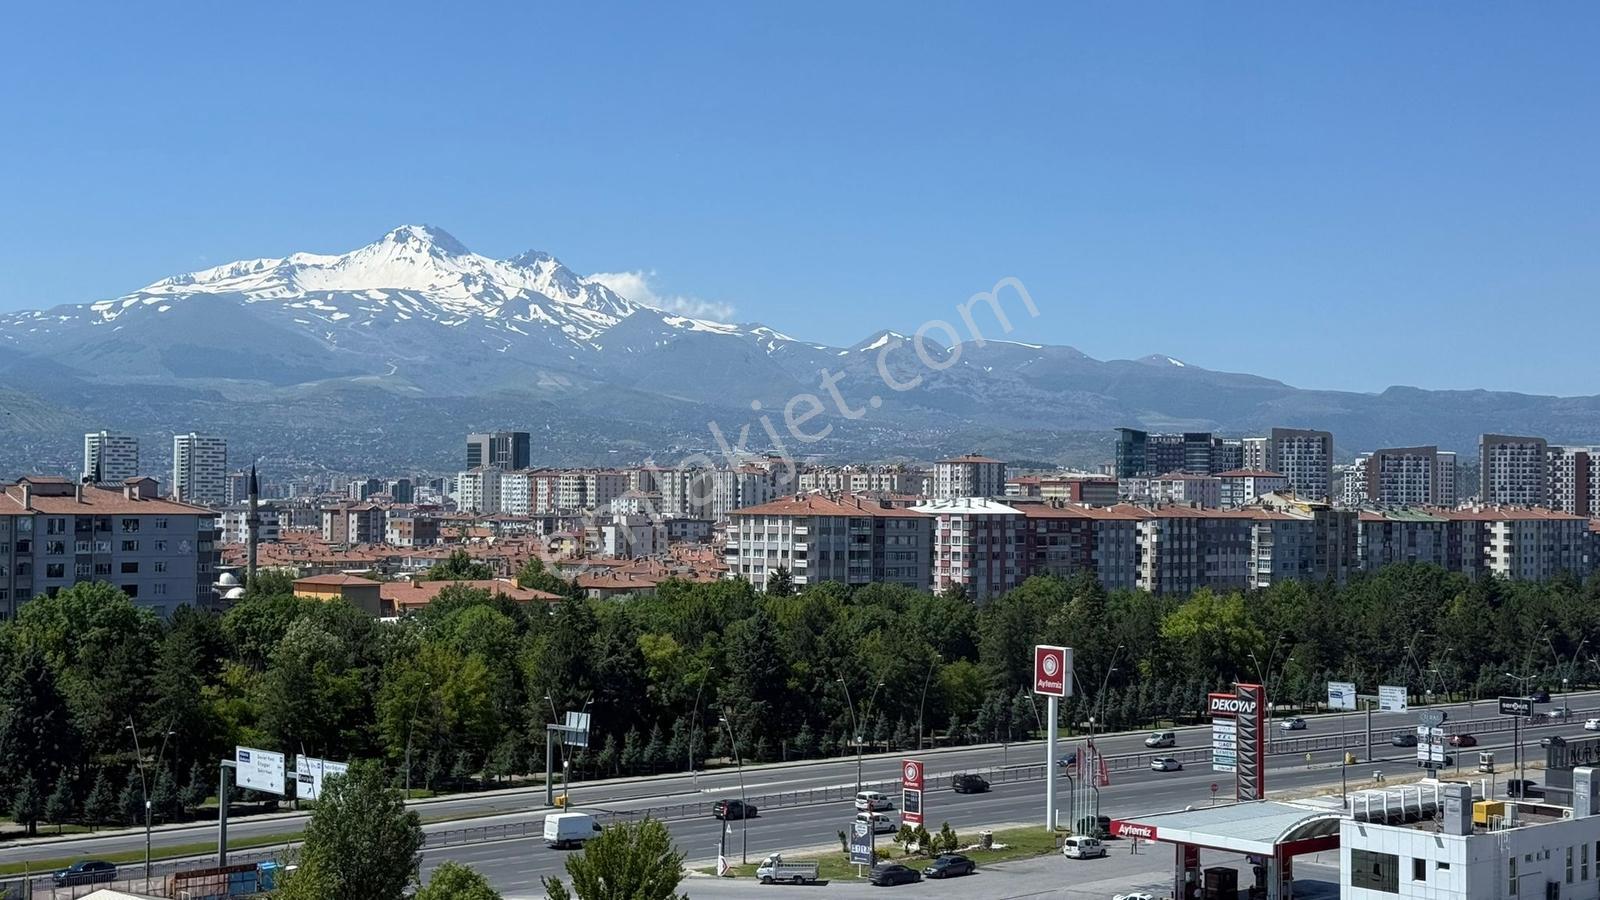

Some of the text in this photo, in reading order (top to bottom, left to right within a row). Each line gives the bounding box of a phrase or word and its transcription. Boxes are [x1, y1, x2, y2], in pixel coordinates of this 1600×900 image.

[1037, 679, 1062, 689] Aytemiz
[1211, 698, 1256, 713] DEKOYAP
[1118, 824, 1151, 837] Aytemiz
